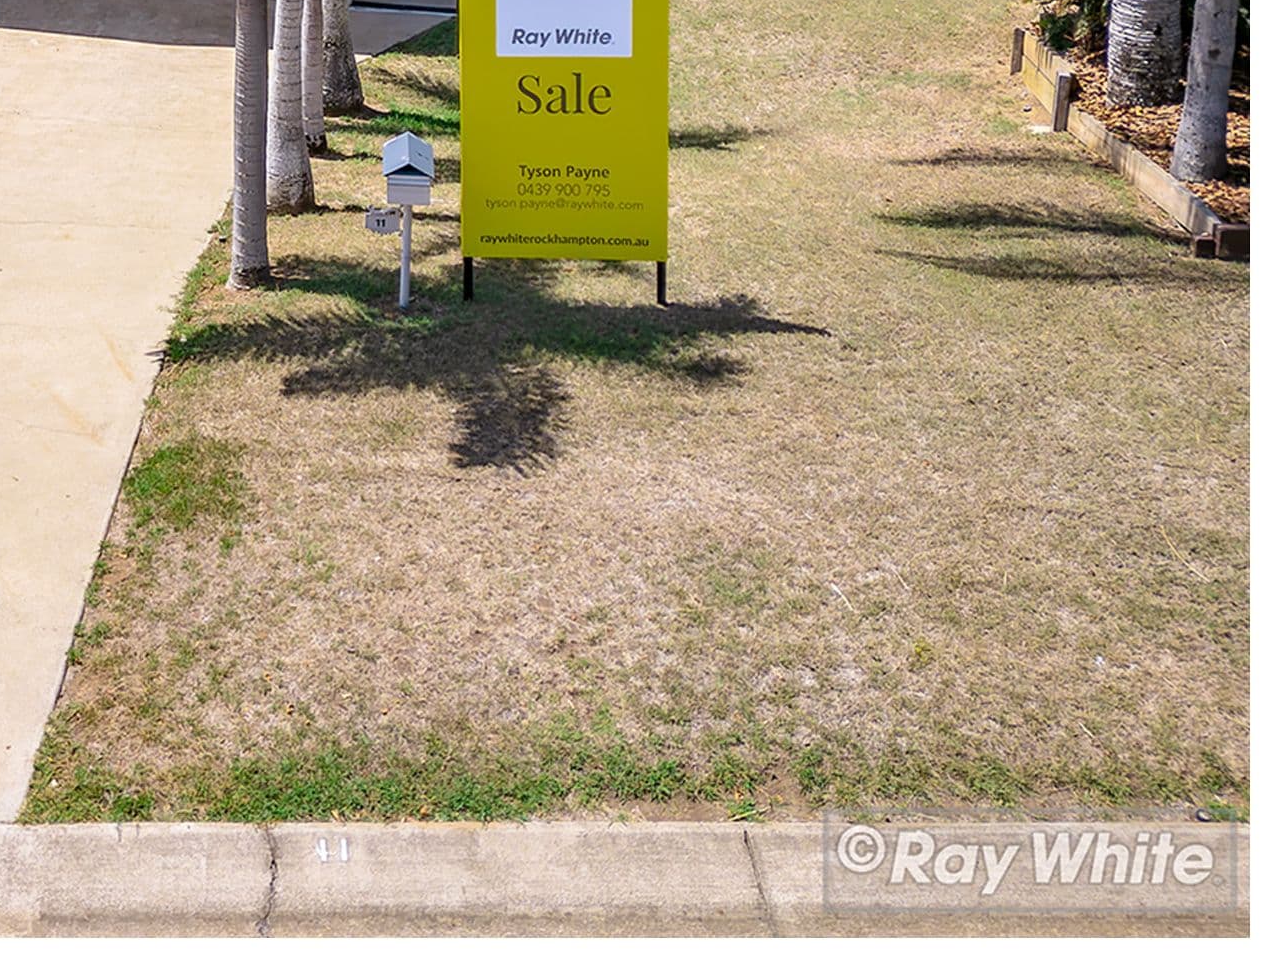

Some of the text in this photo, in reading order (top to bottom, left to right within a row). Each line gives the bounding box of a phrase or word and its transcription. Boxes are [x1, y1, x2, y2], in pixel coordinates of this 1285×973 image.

[512, 28, 612, 48] Ray White
[517, 71, 612, 115] Sale
[518, 164, 611, 181] Tyson Payne
[517, 182, 611, 197] 0439 900 795
[485, 197, 645, 211] tysonpayne@raywhite.com
[479, 233, 650, 247] raywhiterockhampton.com.au
